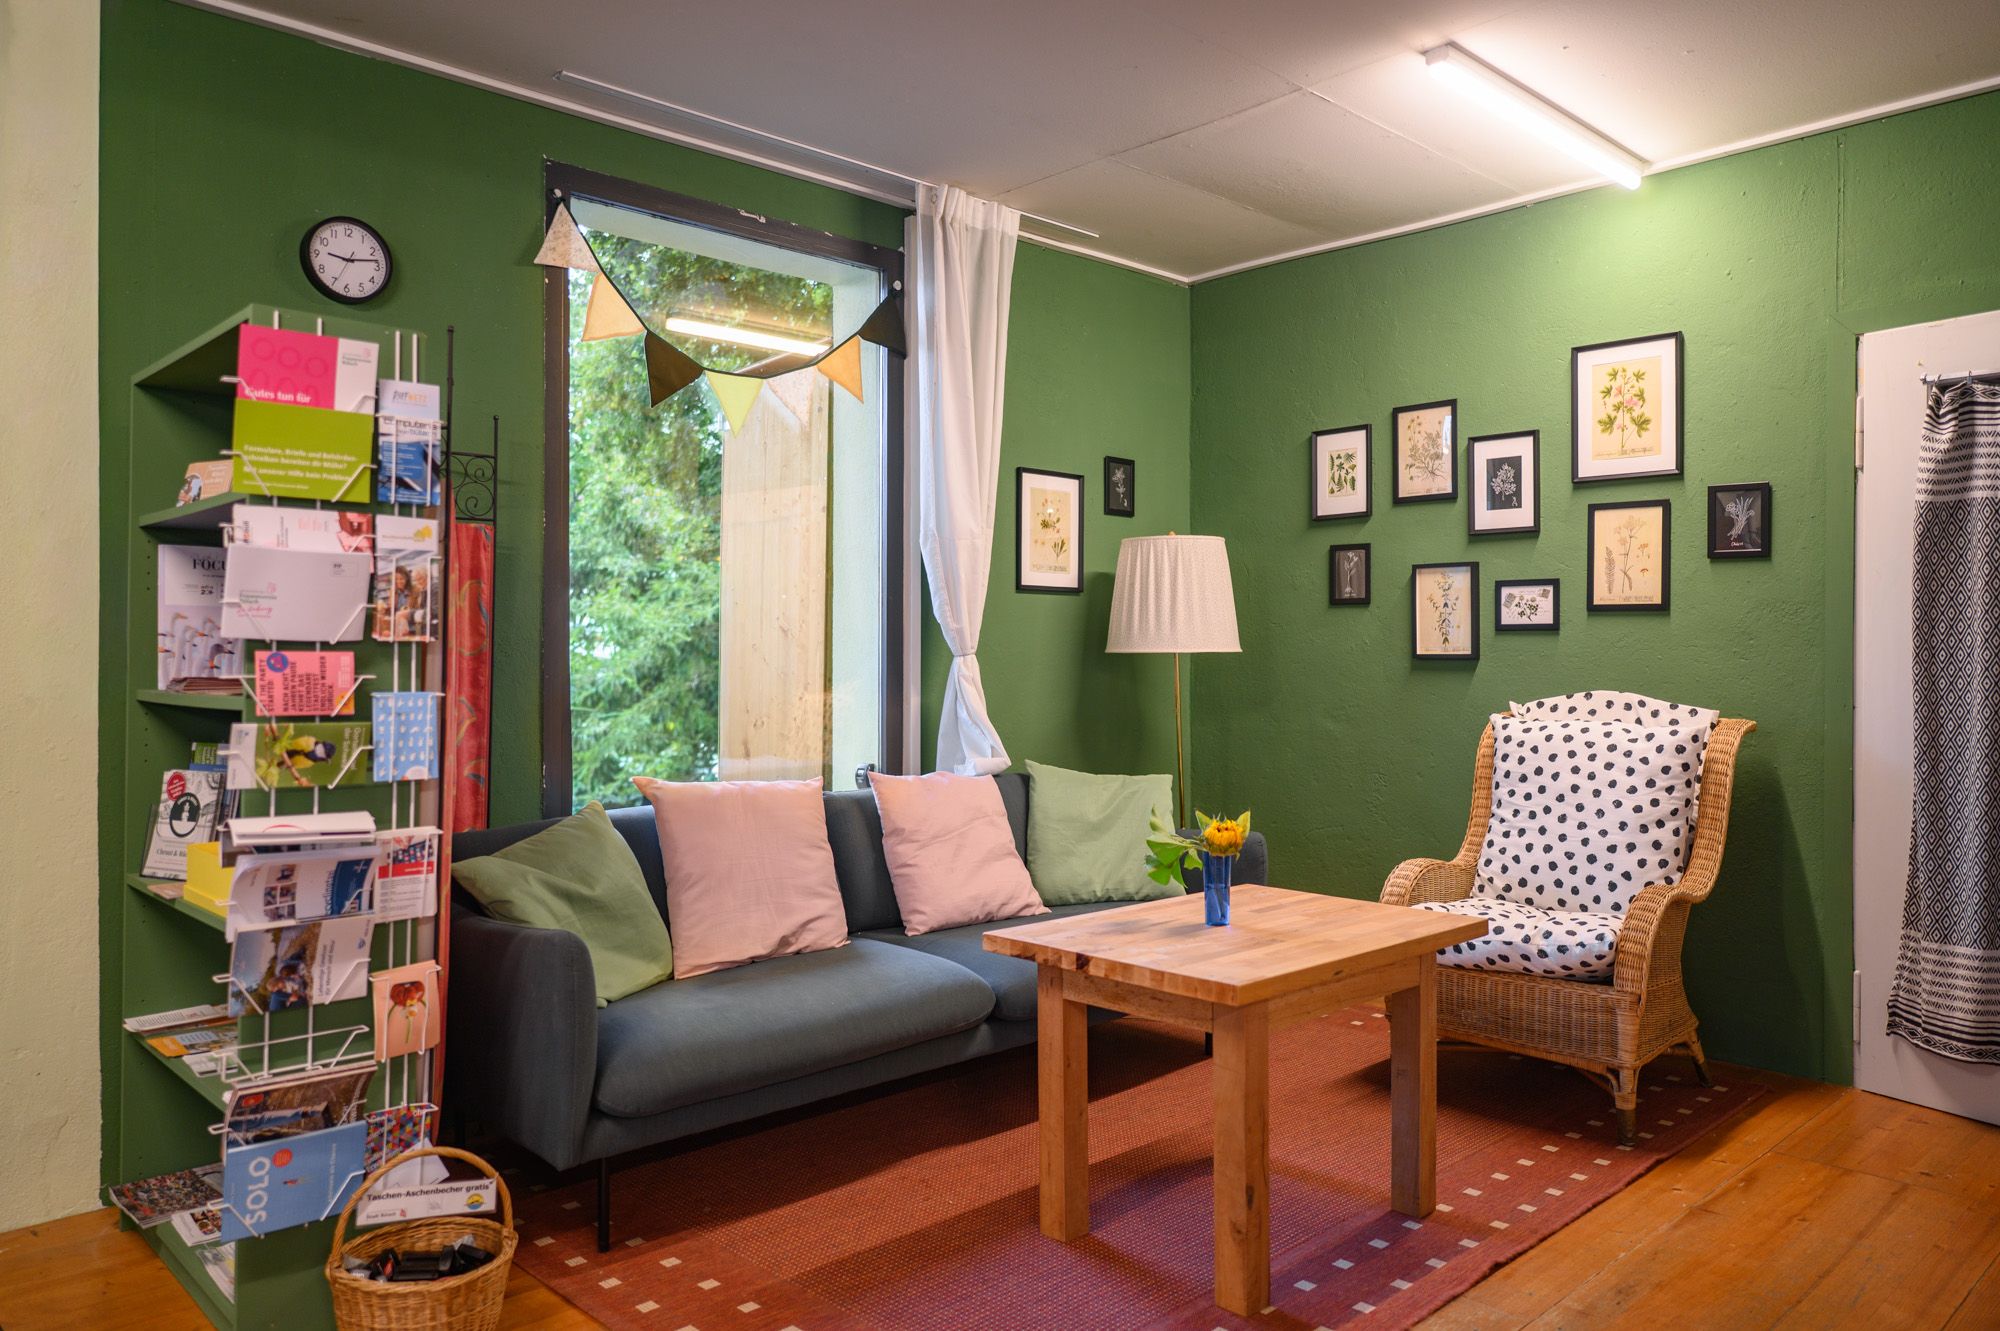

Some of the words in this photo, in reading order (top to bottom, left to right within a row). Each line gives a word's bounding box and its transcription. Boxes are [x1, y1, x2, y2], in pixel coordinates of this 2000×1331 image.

[330, 229, 338, 239] 11
[344, 228, 352, 238] 12
[320, 236, 329, 247] 10
[361, 234, 364, 244] 1
[314, 249, 320, 258] 9
[370, 246, 376, 256] 2
[318, 264, 325, 274] 8
[374, 262, 380, 272] 3
[331, 276, 338, 286] 7
[369, 276, 375, 285] 4
[344, 284, 350, 294] 6
[358, 282, 364, 292] 5
[277, 390, 294, 402] tun
[296, 392, 312, 404] für
[244, 454, 278, 463] chreiben
[341, 740, 350, 769] Schwei
[243, 1156, 272, 1226] SOLO
[367, 1184, 463, 1201] Taschen-Aschenbecher
